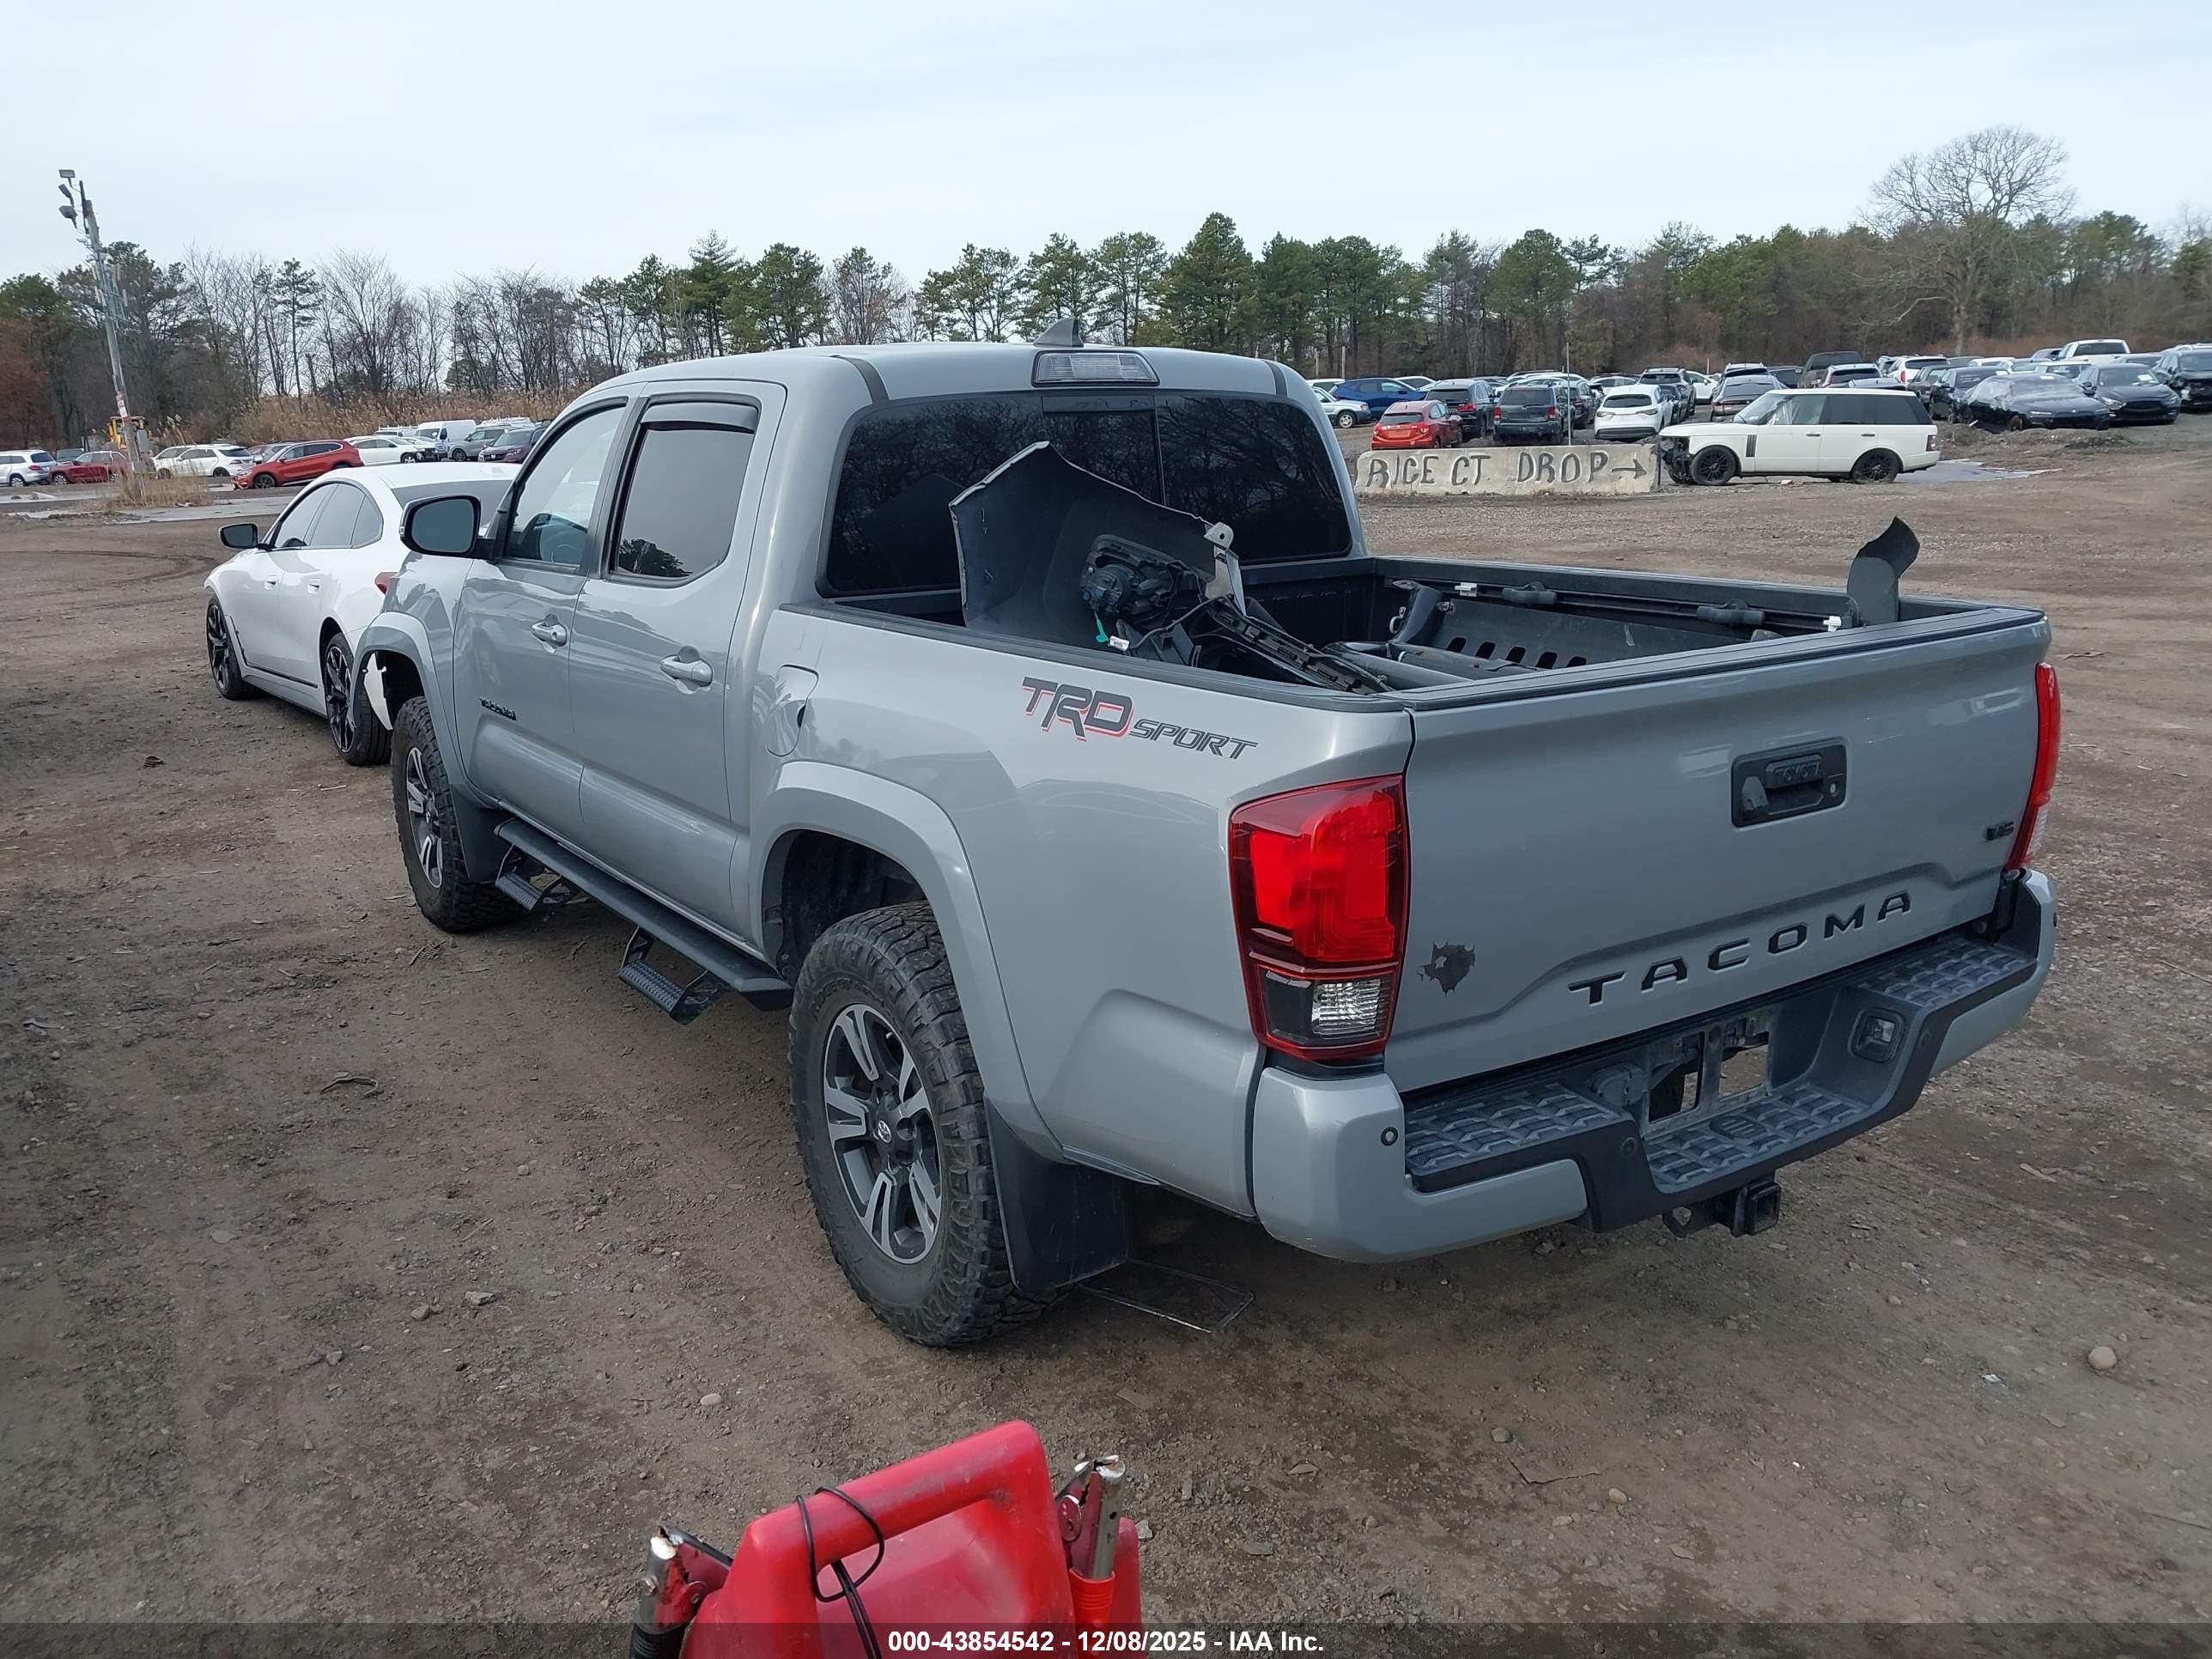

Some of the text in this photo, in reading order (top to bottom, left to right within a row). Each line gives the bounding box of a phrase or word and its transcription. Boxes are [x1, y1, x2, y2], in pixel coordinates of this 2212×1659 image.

[1450, 454, 1492, 486] CT
[1516, 451, 1608, 483] DROP
[1022, 677, 1259, 760] TRD SPORT
[1567, 890, 1911, 1006] TACOMA
